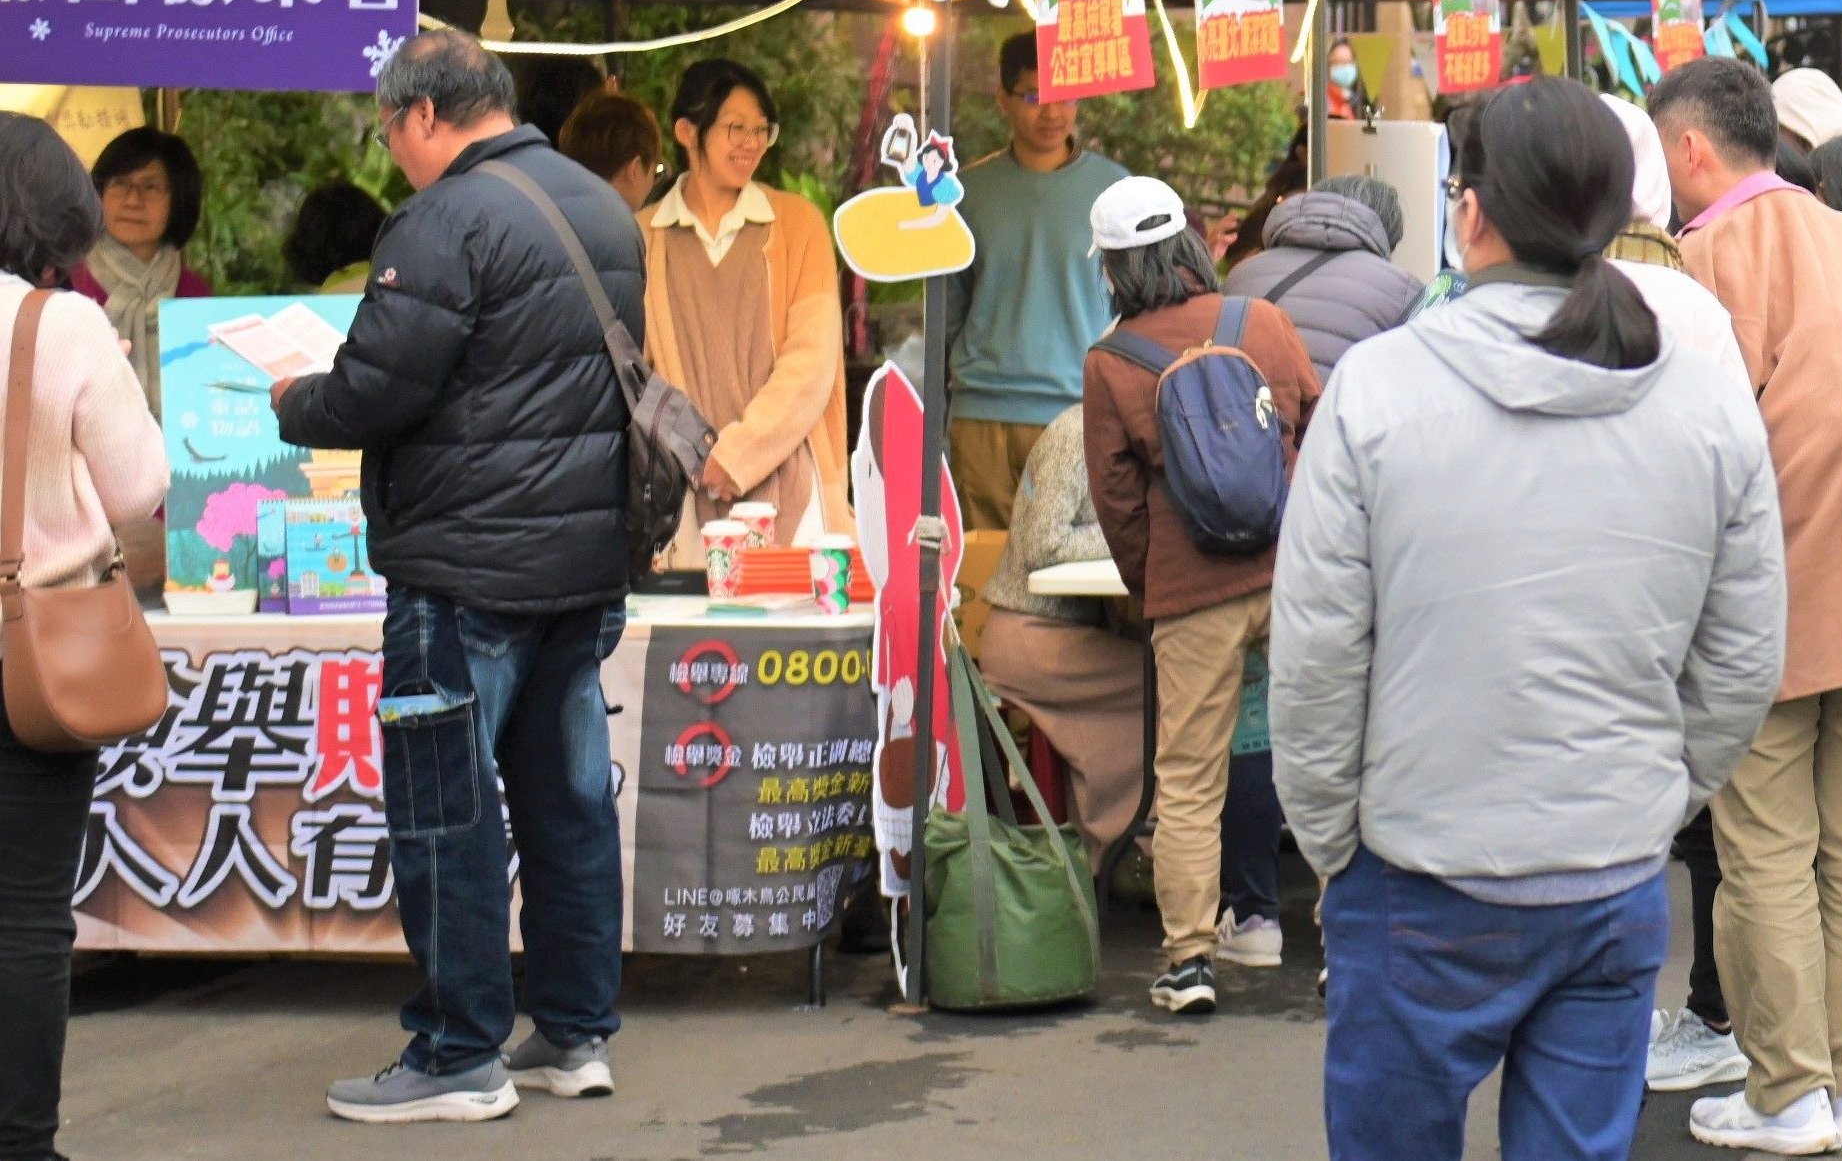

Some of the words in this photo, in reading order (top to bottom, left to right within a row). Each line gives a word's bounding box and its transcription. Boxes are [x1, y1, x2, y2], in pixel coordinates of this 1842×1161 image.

[84, 22, 150, 43] Supreme
[157, 23, 246, 40] Prosecutors
[251, 24, 294, 45] Office
